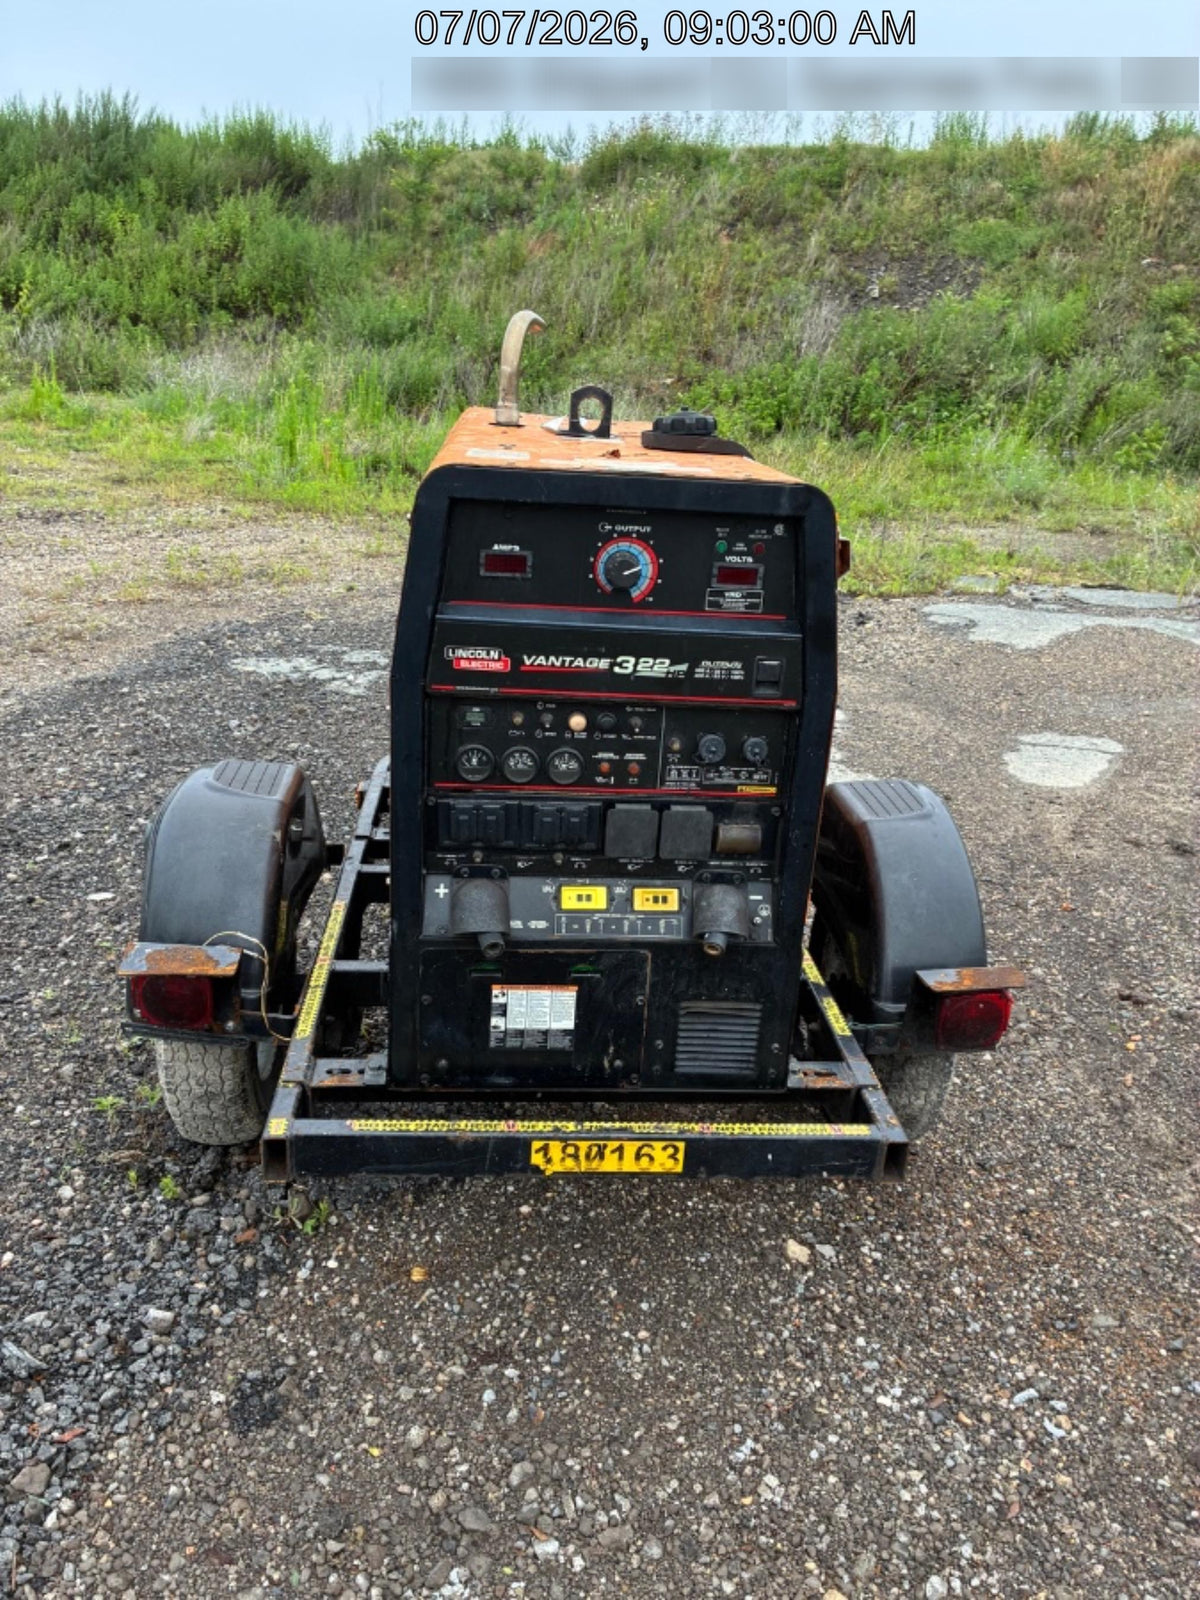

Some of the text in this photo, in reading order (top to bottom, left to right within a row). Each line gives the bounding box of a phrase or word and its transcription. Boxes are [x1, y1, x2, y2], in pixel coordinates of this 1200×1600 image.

[614, 524, 653, 533] OUTPUT
[492, 543, 520, 552] AMPS
[725, 555, 753, 563] VOLTS
[449, 648, 500, 660] LINCOLN
[459, 658, 504, 669] ELECTRIC
[522, 654, 612, 670] VANTAGE
[613, 655, 671, 675] 322
